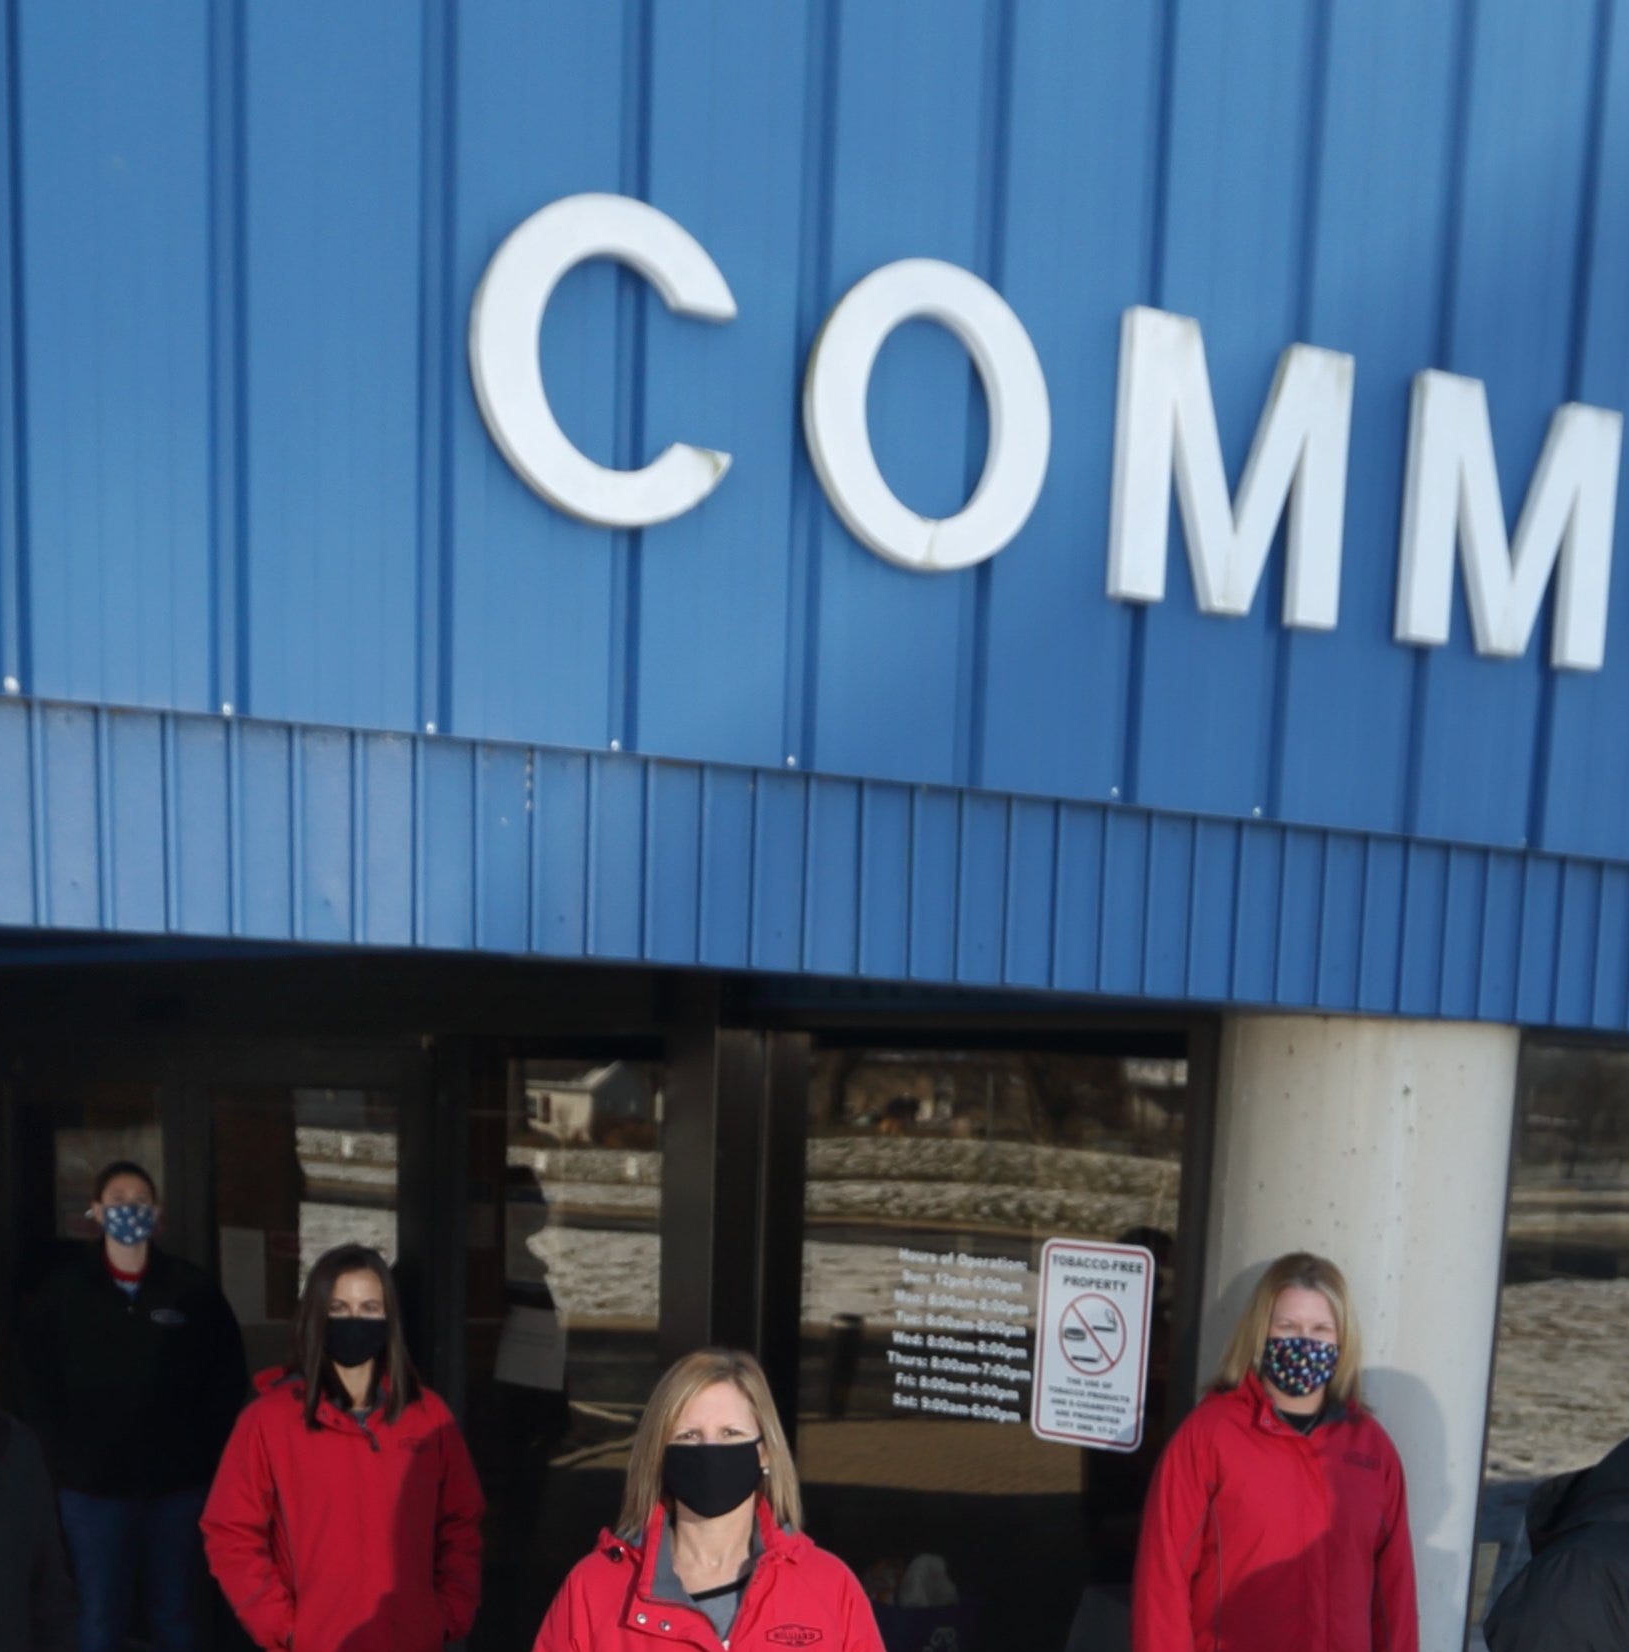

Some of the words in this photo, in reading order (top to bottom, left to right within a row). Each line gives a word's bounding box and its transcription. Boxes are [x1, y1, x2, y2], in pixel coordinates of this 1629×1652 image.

[898, 1247, 937, 1264] Hours
[939, 1252, 954, 1265] of
[1052, 1254, 1144, 1274] TOBACCO-FREE
[1063, 1275, 1127, 1292] PROPERTY
[892, 1330, 924, 1346] Wed:
[887, 1350, 928, 1368] Thurs:
[895, 1372, 917, 1387] Fri:
[892, 1392, 918, 1408] Sat:
